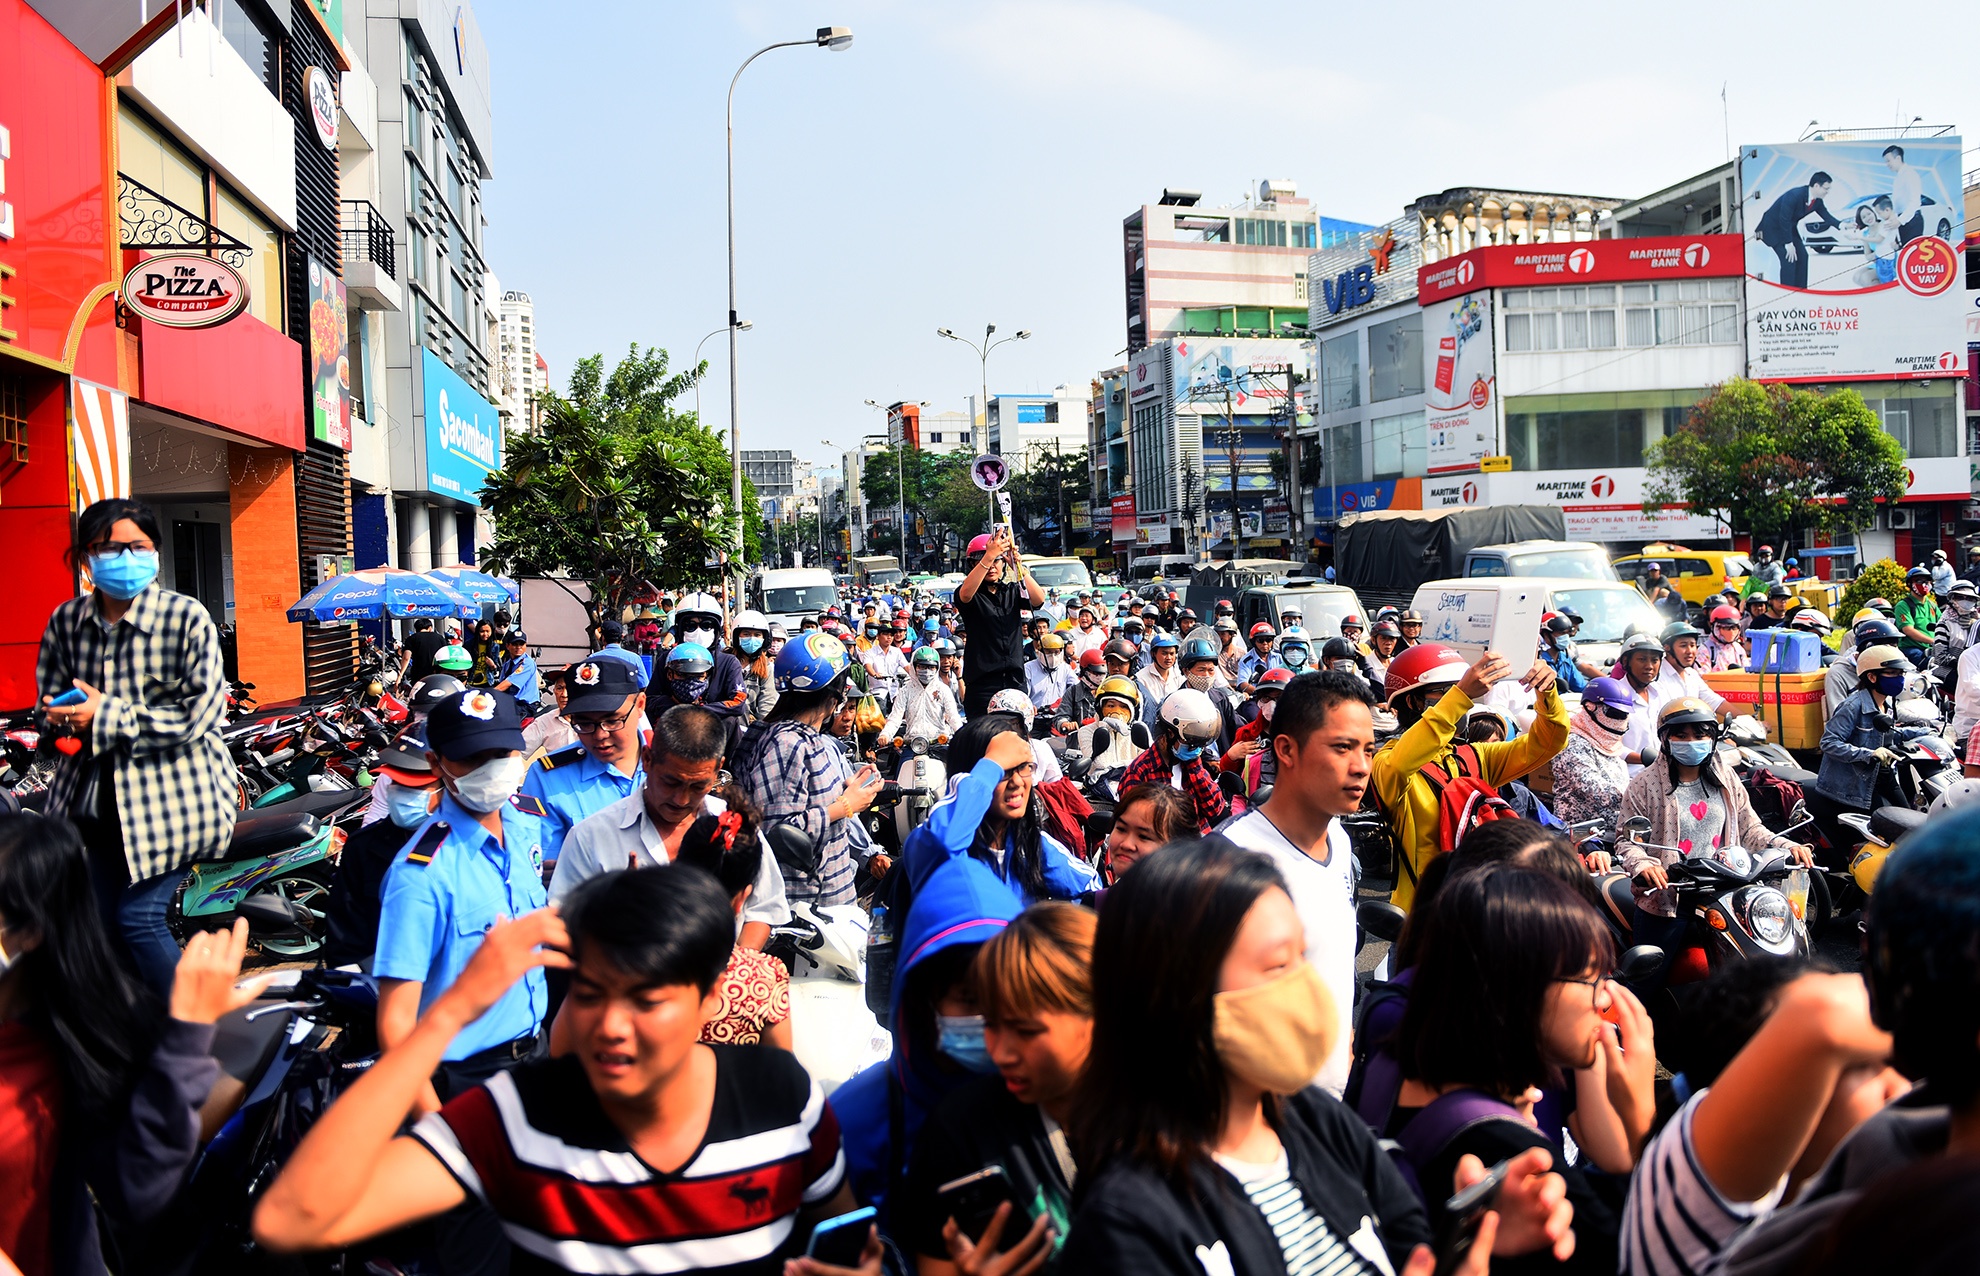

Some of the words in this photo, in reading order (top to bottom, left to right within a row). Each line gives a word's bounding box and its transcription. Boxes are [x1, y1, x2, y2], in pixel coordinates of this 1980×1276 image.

[1629, 248, 1681, 259] MARITIME
[1513, 254, 1566, 266] MARITIME
[1651, 257, 1680, 269] BANK
[173, 266, 196, 277] The
[1535, 263, 1564, 274] BANK
[1425, 267, 1457, 285] MARITIME
[1918, 275, 1937, 284] VAY
[145, 273, 225, 296] PIZZA
[1438, 276, 1456, 290] BANK
[1322, 264, 1377, 314] VIB
[157, 300, 209, 311] Company
[1758, 311, 1779, 320] VAY
[1782, 308, 1806, 319] VỐN
[1826, 307, 1859, 318] DÀNG
[1785, 321, 1817, 332] SÀNG
[1895, 356, 1937, 364] MARITIME
[439, 388, 494, 467] Sacombank
[1536, 481, 1586, 491] MARITIME
[1431, 487, 1460, 497] MARITIME
[1556, 491, 1584, 500] BANK
[1360, 495, 1377, 508] VIB
[1442, 496, 1459, 505] BANK
[332, 588, 378, 601] pepsi
[393, 587, 438, 597] pepsi
[346, 607, 369, 616] pepsi
[290, 848, 321, 863] Kawasaki
